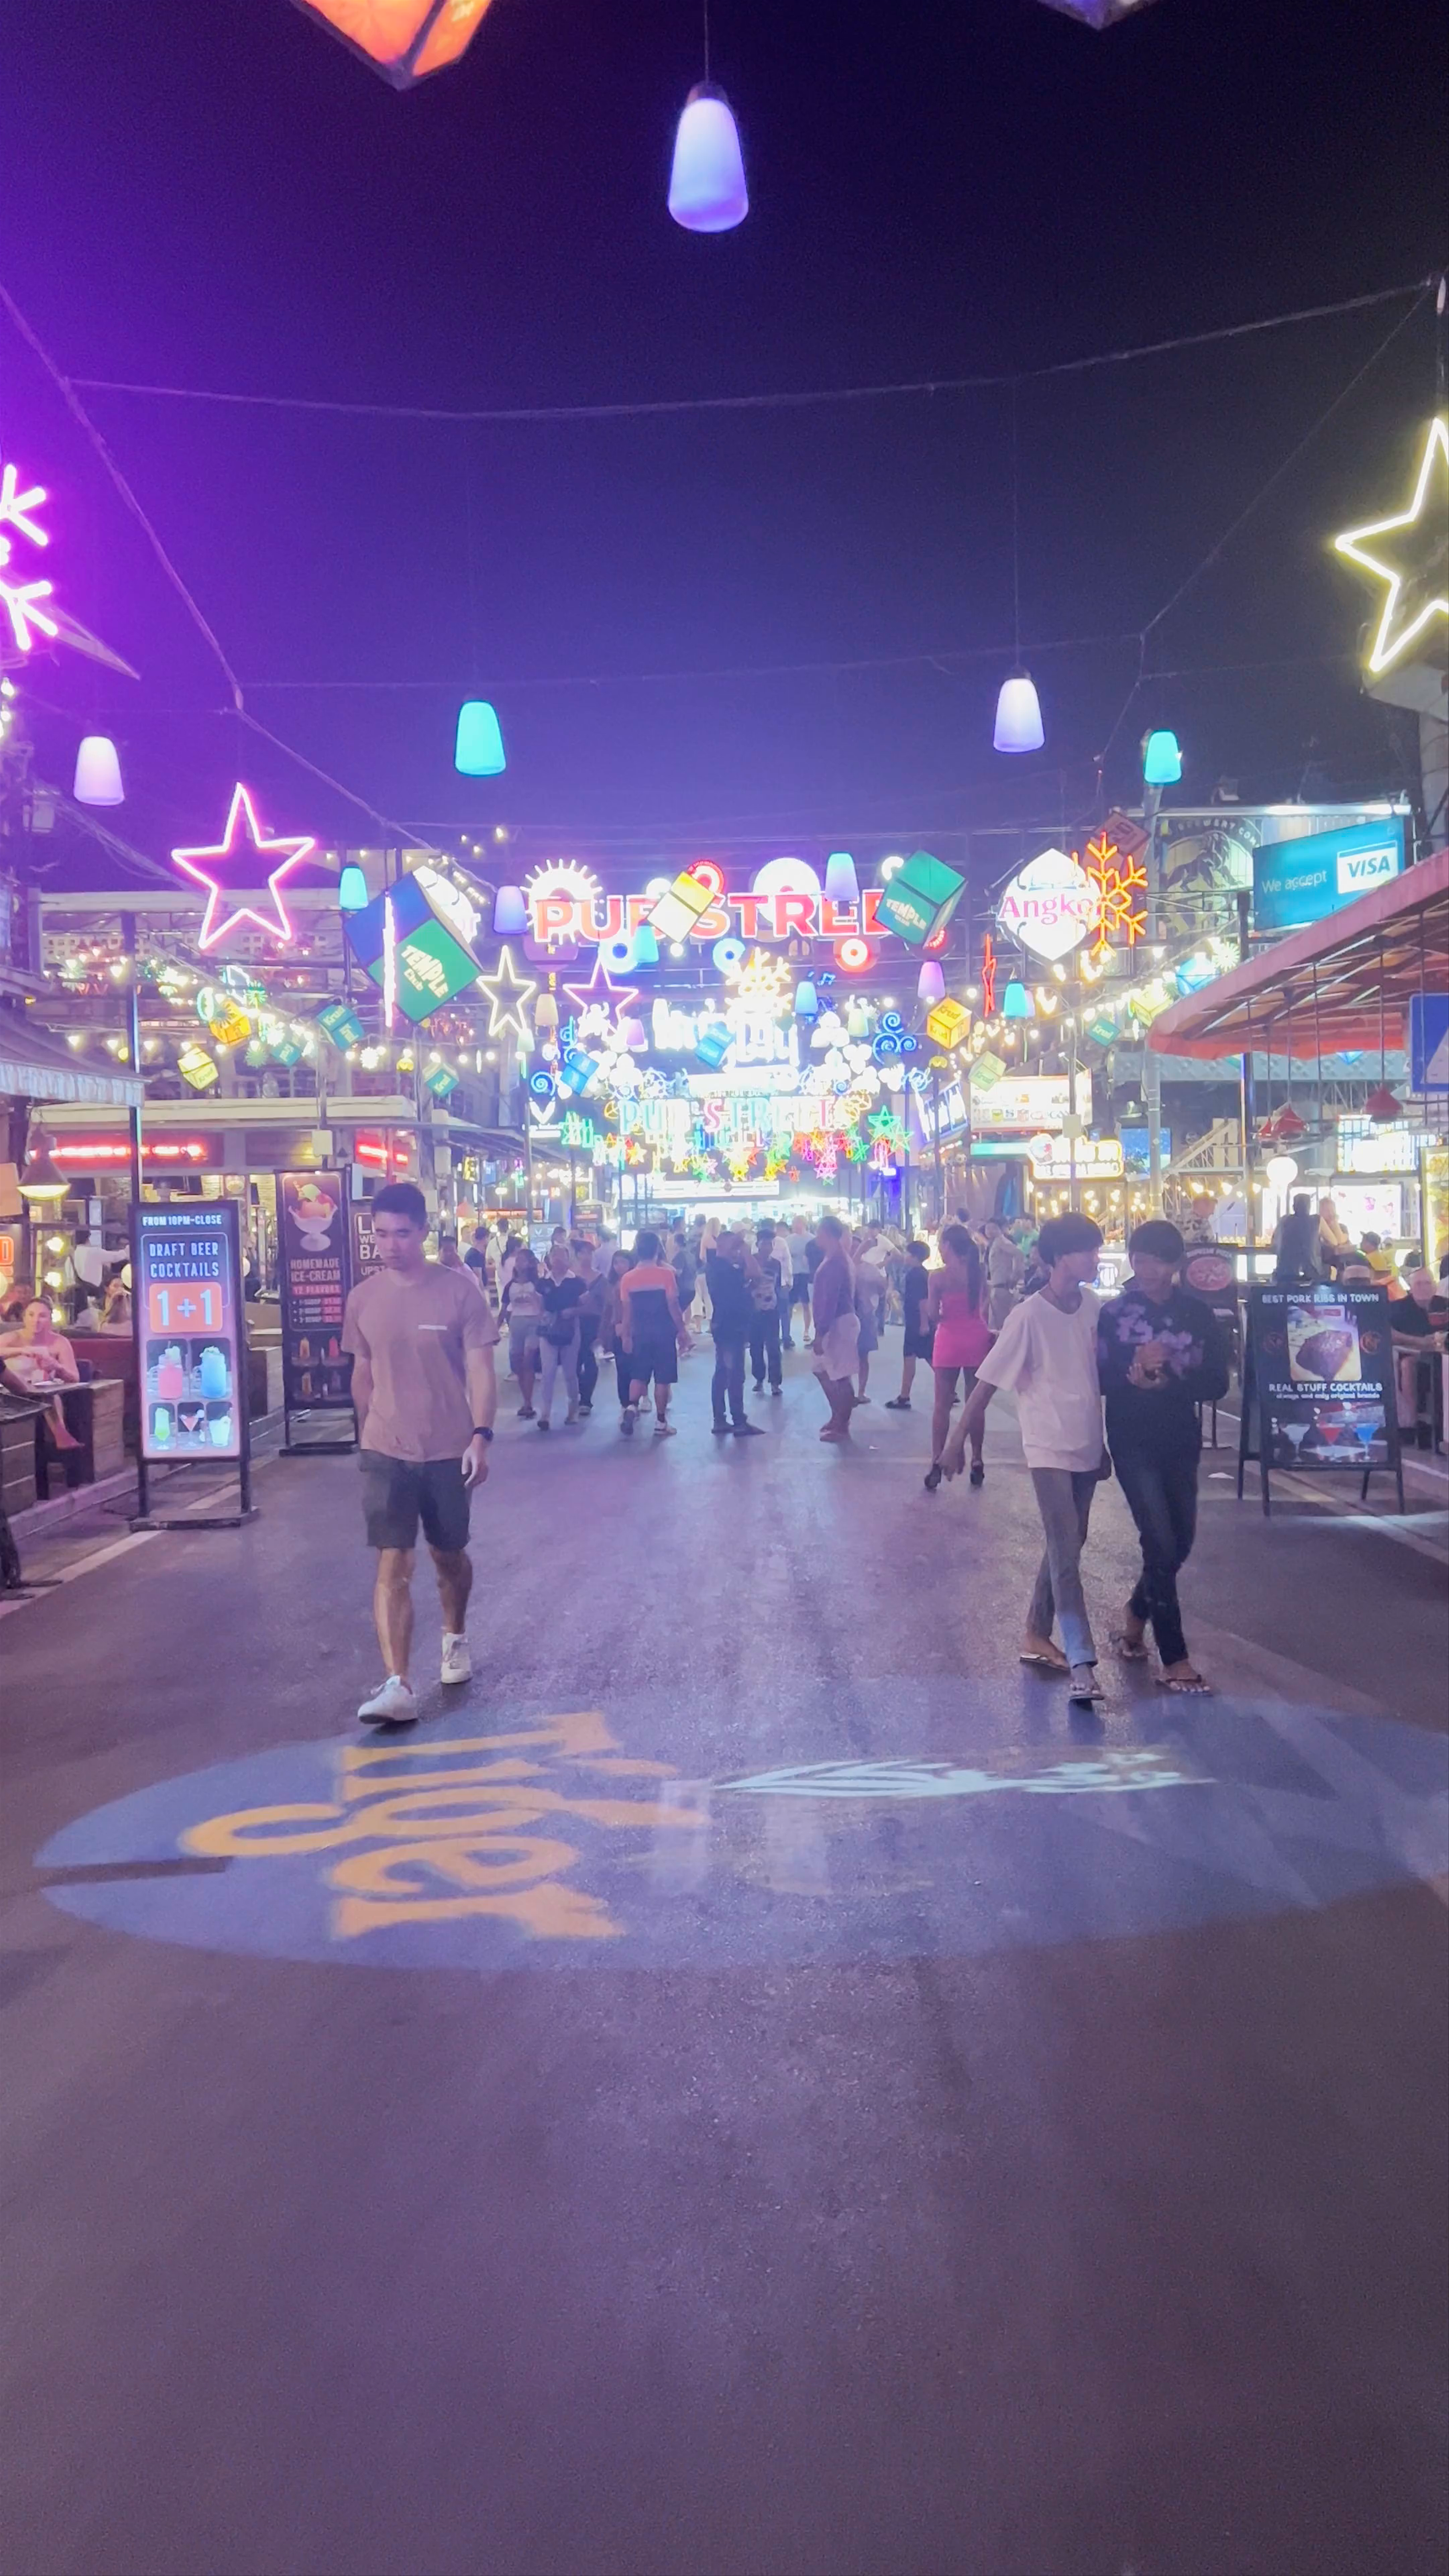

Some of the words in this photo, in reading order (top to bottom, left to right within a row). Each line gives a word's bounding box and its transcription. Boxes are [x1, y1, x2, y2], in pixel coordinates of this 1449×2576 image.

[1347, 855, 1391, 878] VISA
[1261, 879, 1281, 894] We
[1284, 870, 1327, 889] accept
[401, 945, 449, 998] TEMPLE
[142, 1216, 167, 1226] FROM
[168, 1215, 222, 1225] 10PM-CLOSE
[149, 1243, 185, 1256] DRAFT
[191, 1242, 218, 1256] BEER
[360, 1244, 384, 1260] BA
[150, 1262, 219, 1278] COCKTAILS
[290, 1258, 339, 1269] HOMEMADE
[291, 1270, 341, 1282] ICE-CREAM
[1262, 1294, 1284, 1304] BEST
[1287, 1294, 1311, 1303] PORK
[1314, 1294, 1335, 1303] RIBS
[1337, 1294, 1347, 1302] IN
[1350, 1293, 1379, 1302] TOWN
[1269, 1384, 1294, 1392] REAL
[1297, 1383, 1327, 1392] STUFF
[1330, 1382, 1383, 1392] COCKTAILS
[178, 1710, 711, 1942] Tiger
